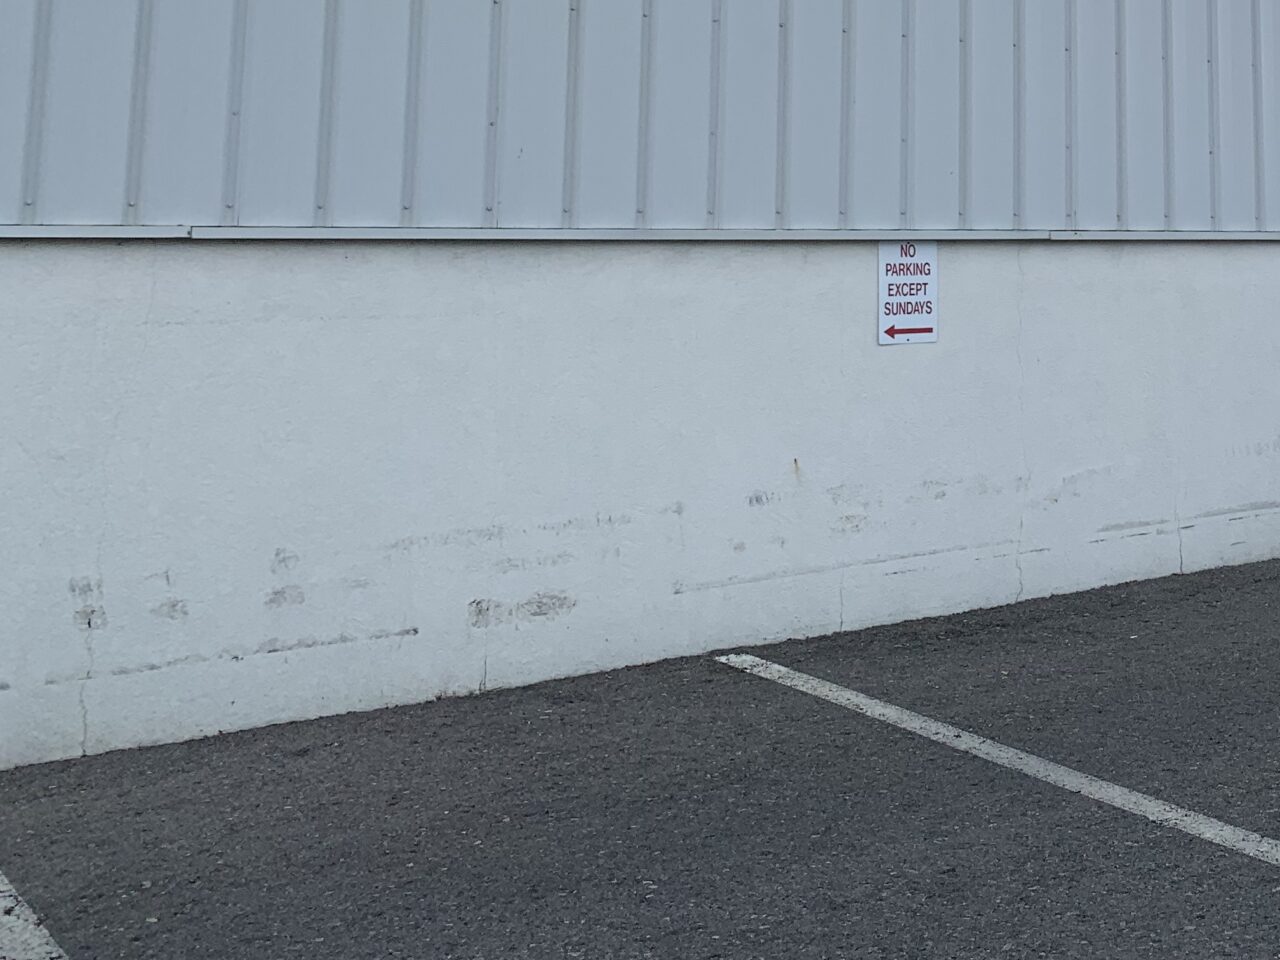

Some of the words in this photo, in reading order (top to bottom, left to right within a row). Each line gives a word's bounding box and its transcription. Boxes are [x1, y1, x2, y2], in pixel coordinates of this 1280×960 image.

[900, 244, 916, 258] NO
[885, 262, 931, 276] PARKING
[887, 282, 928, 297] EXCEPT
[884, 301, 933, 316] SUNDAYS
